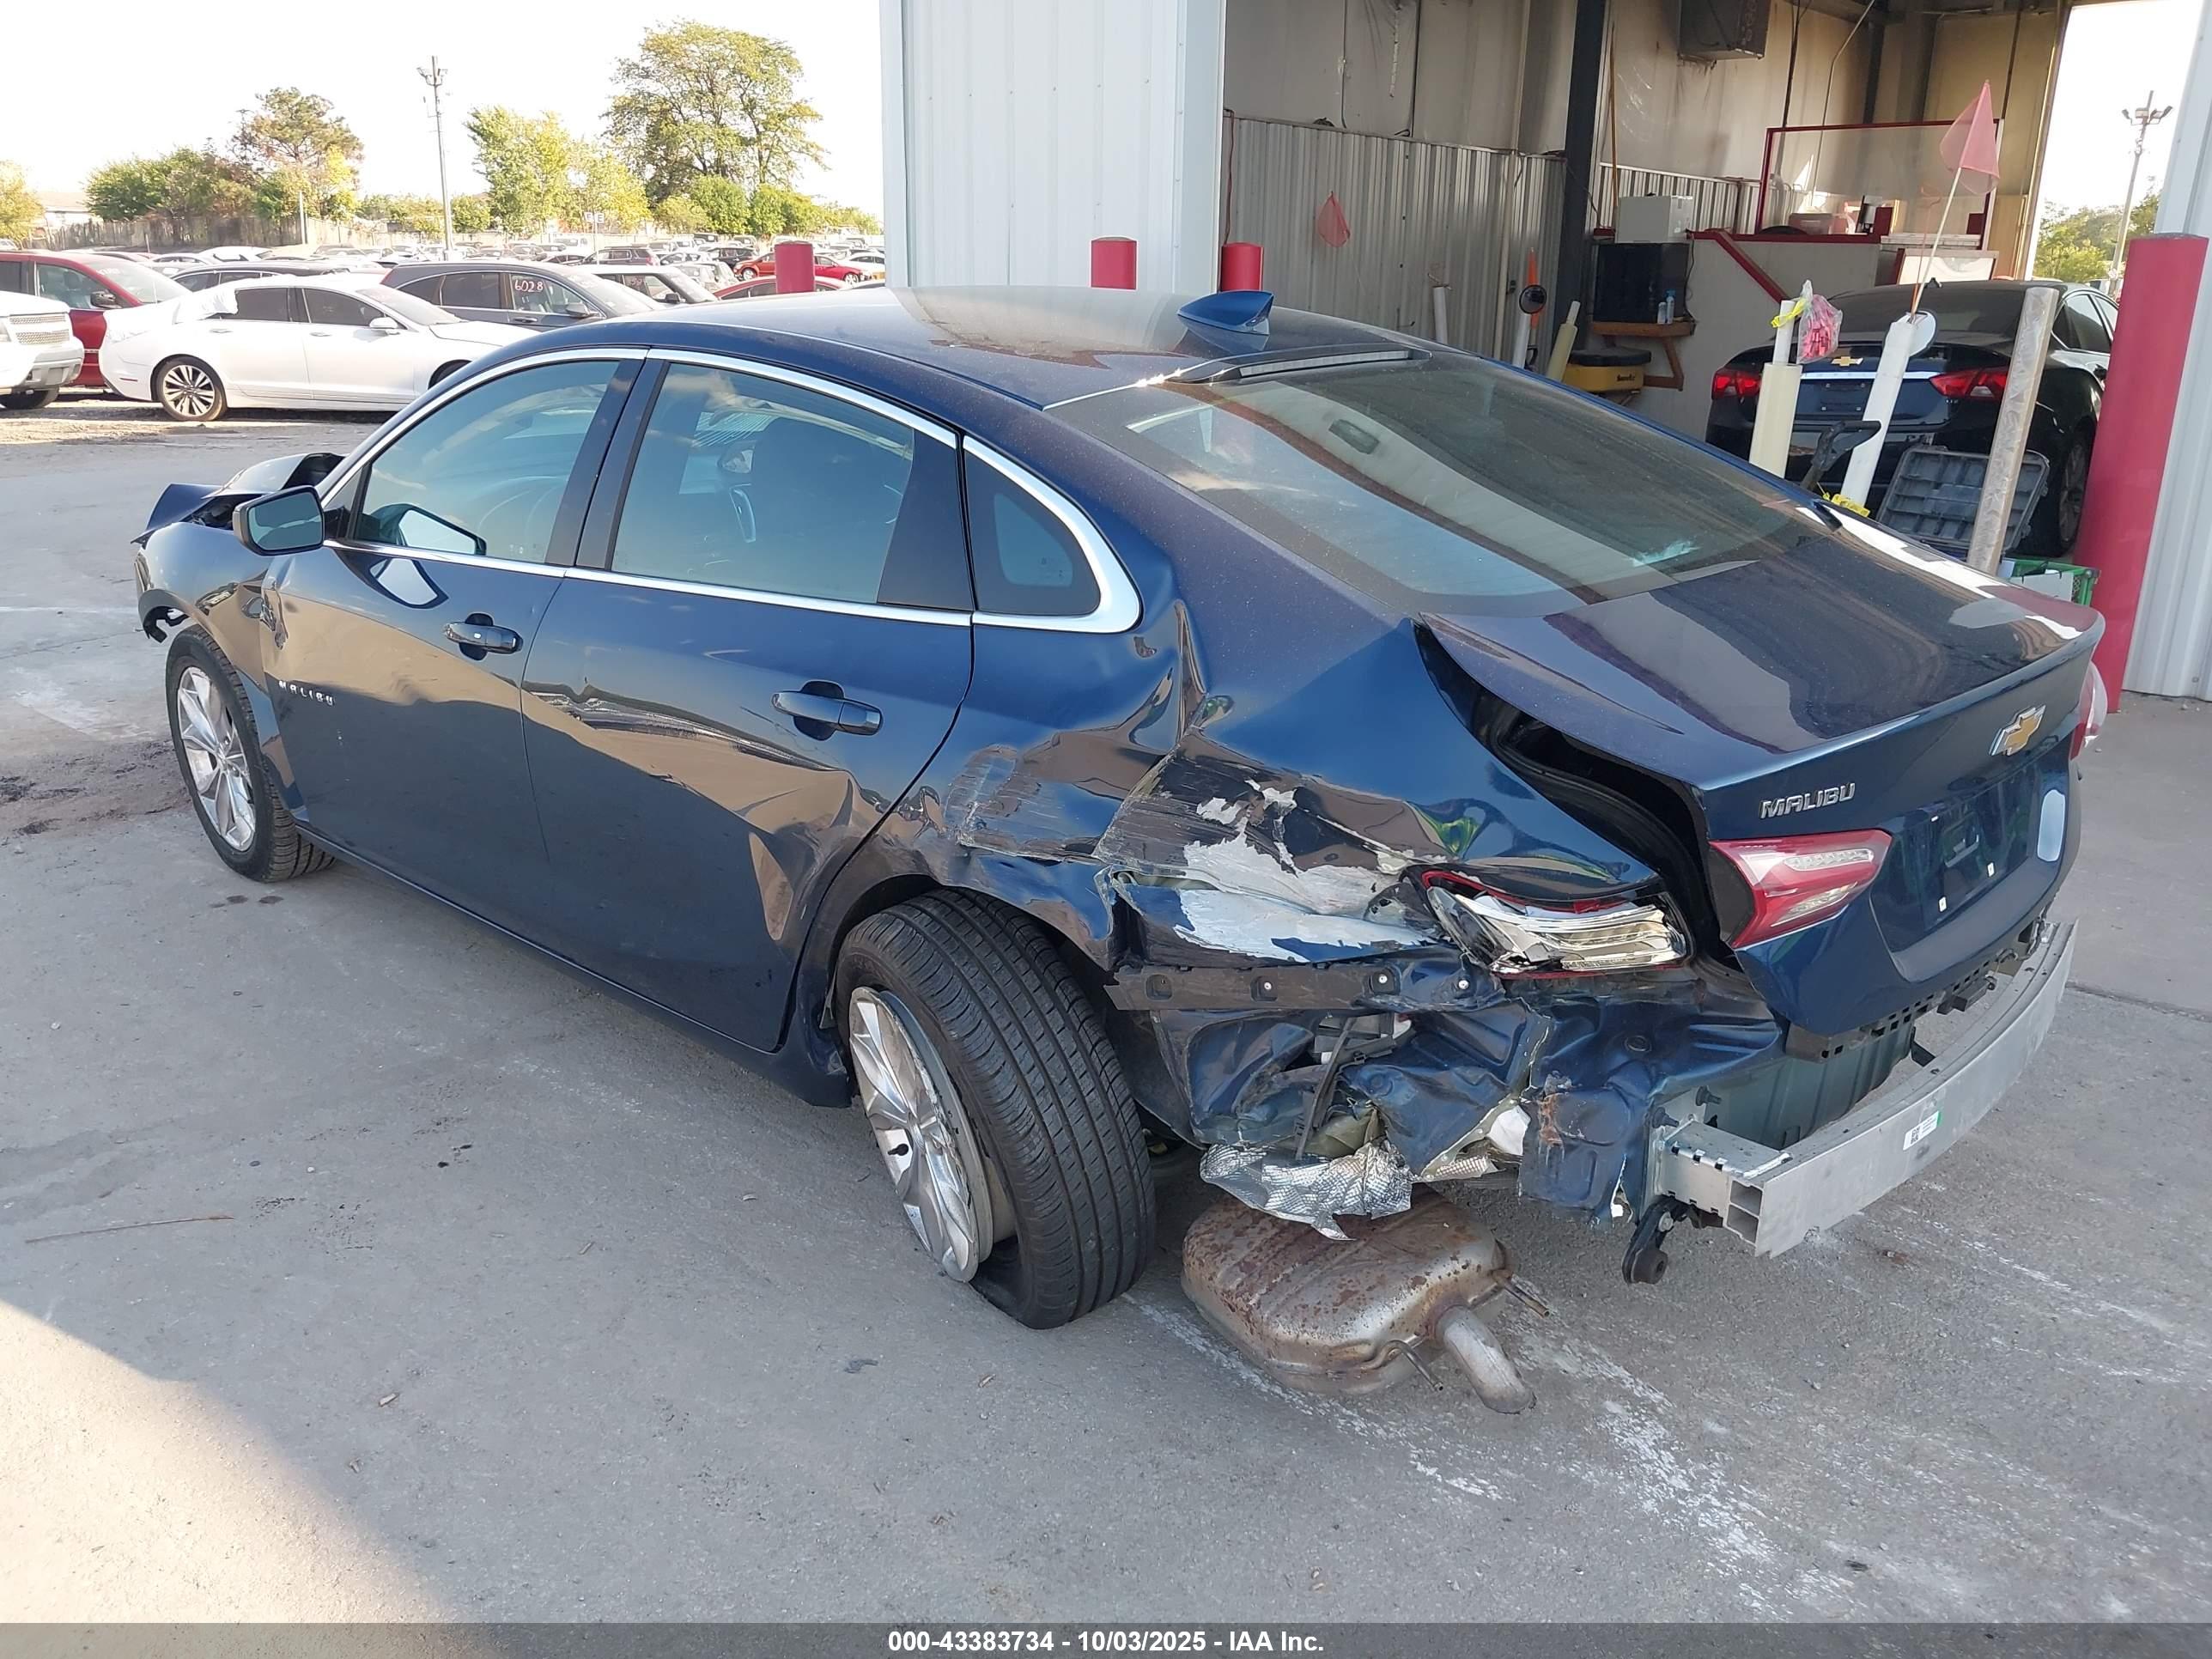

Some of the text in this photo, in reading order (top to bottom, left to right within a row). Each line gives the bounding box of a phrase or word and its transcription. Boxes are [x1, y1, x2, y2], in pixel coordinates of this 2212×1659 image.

[514, 279, 544, 293] 6028
[278, 680, 333, 706] MALIBU
[1759, 782, 1856, 819] MALIBU
